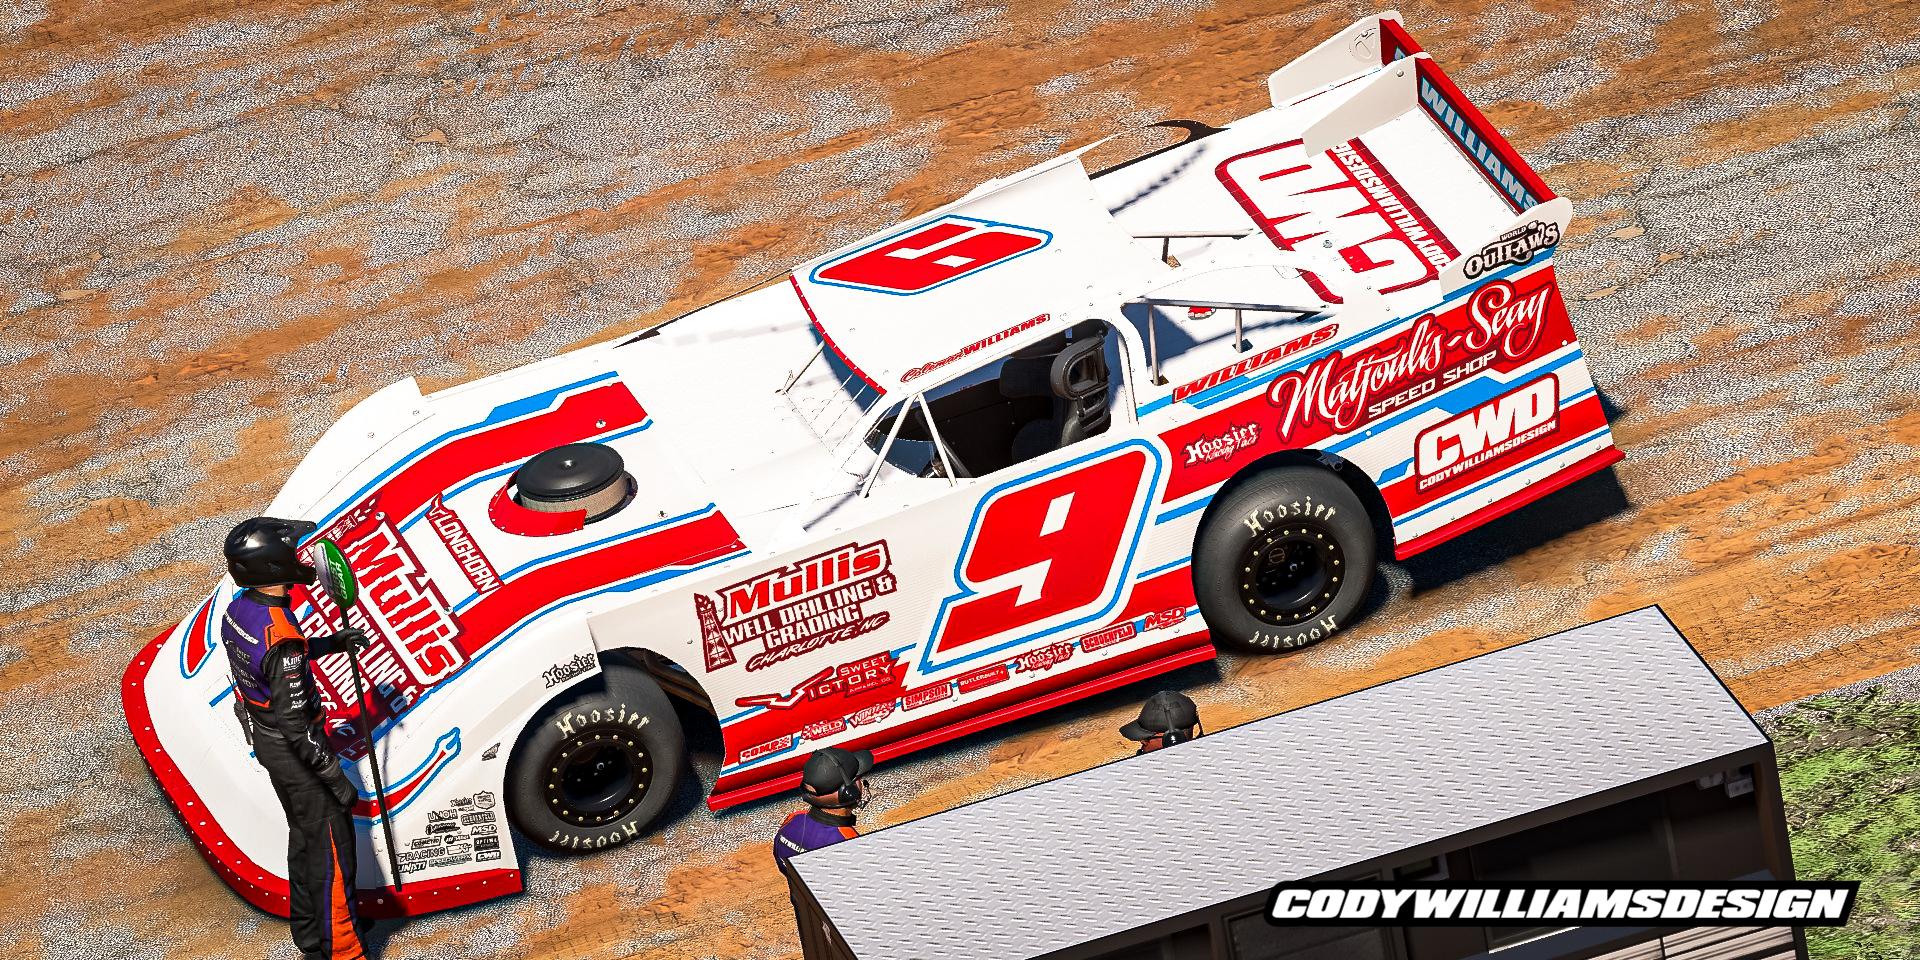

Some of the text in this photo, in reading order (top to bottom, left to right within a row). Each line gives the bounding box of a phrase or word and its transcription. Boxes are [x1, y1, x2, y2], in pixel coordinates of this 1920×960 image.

[1420, 75, 1539, 211] WILLIAMS
[1501, 226, 1527, 241] WORLD
[816, 221, 1043, 292] 9
[961, 314, 1050, 356] WILLIAMS
[1174, 325, 1338, 401] WILLIAMS
[1368, 350, 1497, 419] SPEED SHOP
[1185, 424, 1257, 464] Hoosier
[1418, 376, 1556, 476] CWD
[1419, 420, 1557, 489] CODYWILLIAMSDESIGN
[1244, 495, 1336, 538] Hoosier
[433, 513, 501, 592] LONGHORN
[928, 447, 1150, 656] 9
[344, 528, 459, 679] Mullis
[728, 546, 883, 620] Mullis
[722, 574, 894, 646] WELL DRILLING &
[765, 604, 860, 649] GRADING
[1145, 607, 1186, 630] MSD
[1017, 645, 1070, 671] Hoosier
[1083, 625, 1133, 649] SCHOENFELD
[542, 653, 595, 688] Hoosier
[841, 655, 887, 677] SWEET
[905, 684, 949, 705] SIMPSON
[555, 704, 650, 740] Hoosier
[811, 720, 844, 736] WELD
[428, 809, 458, 822] UNOH
[472, 824, 497, 836] MSD
